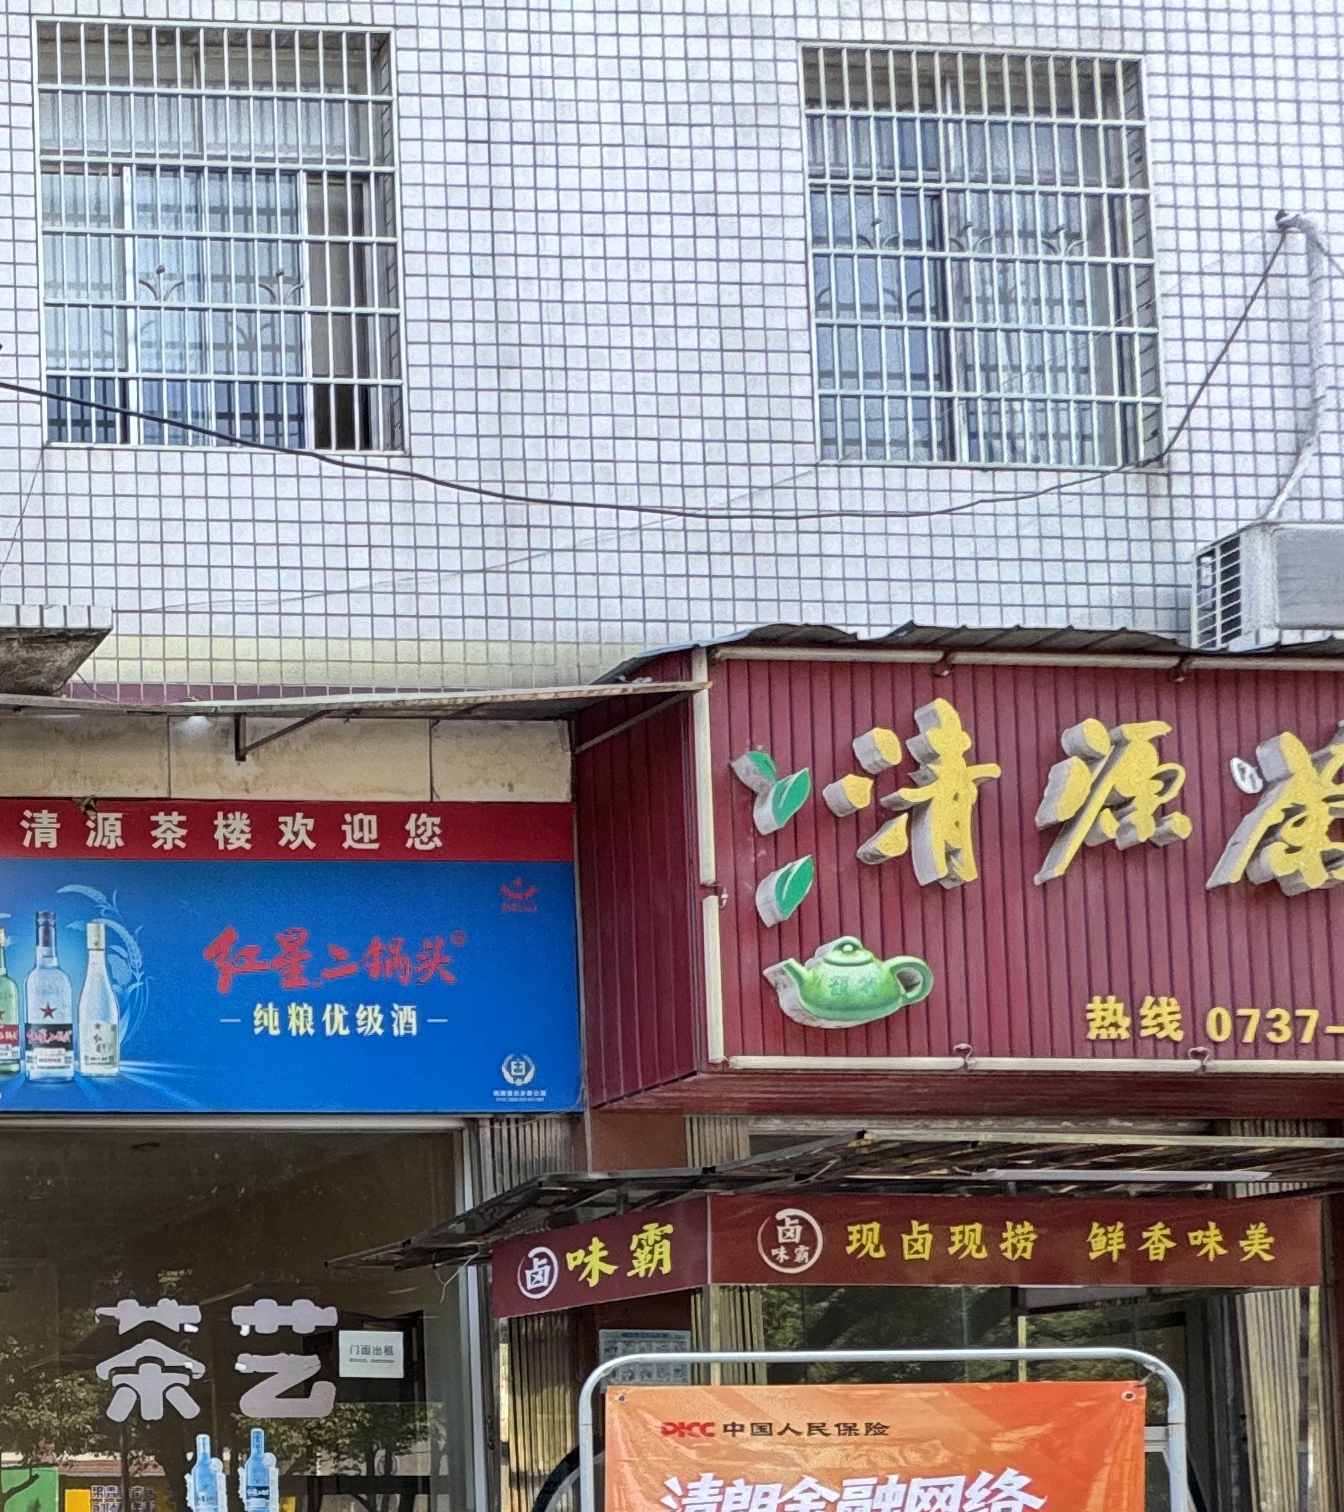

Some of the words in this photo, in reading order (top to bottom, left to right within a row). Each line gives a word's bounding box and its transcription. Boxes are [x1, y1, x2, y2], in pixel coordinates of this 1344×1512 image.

[18, 810, 445, 852] 清源茶楼欢迎您
[203, 923, 459, 996] 红星二锅头
[253, 1001, 420, 1039] 纯粮优级酒
[1085, 994, 1185, 1043] 热线
[844, 1219, 1039, 1262] 现卤现捞
[1086, 1220, 1276, 1263] 鲜香味美
[95, 1297, 339, 1423] 茶艺
[349, 1344, 395, 1356] 门面出租
[659, 1420, 716, 1439] PICC
[721, 1420, 891, 1438] 中国人民保险
